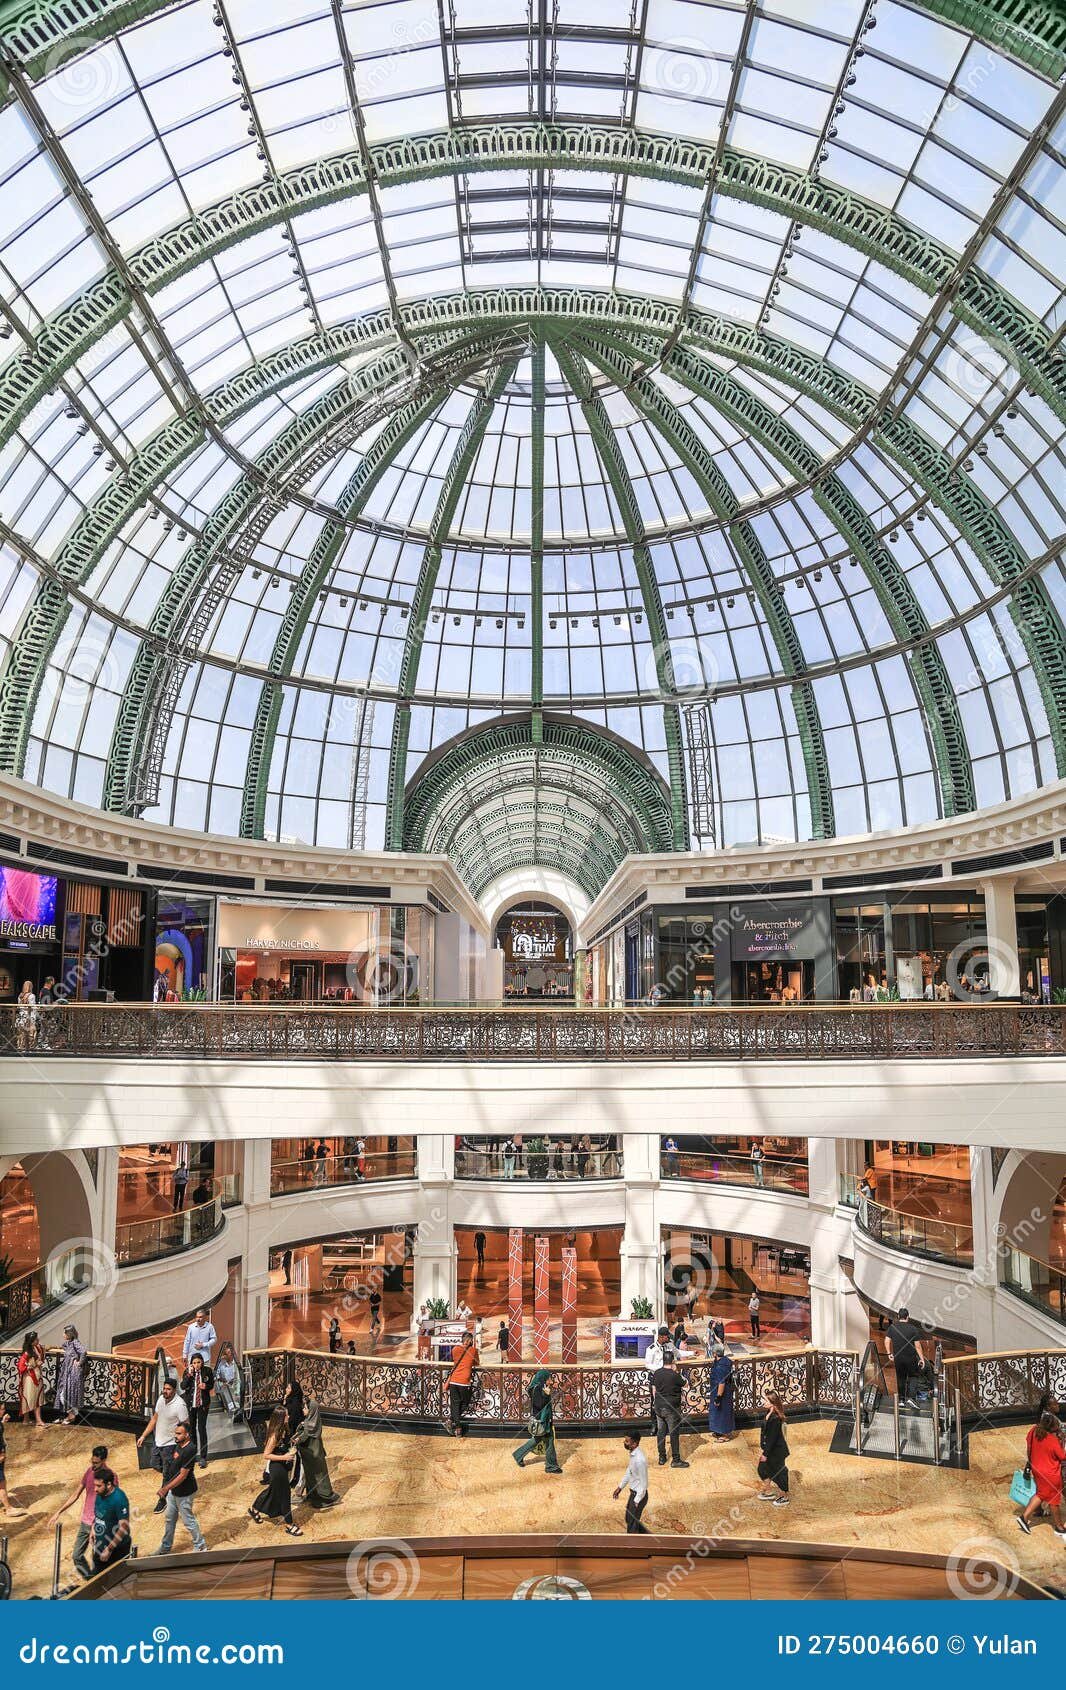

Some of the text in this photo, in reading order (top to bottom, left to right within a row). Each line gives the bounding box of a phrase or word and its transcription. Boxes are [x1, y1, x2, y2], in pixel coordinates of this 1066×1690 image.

[743, 917, 803, 930] Abercrombie
[755, 930, 789, 941] & Fitch
[246, 938, 320, 949] HARVEY NICHOLS
[533, 943, 556, 952] THAT
